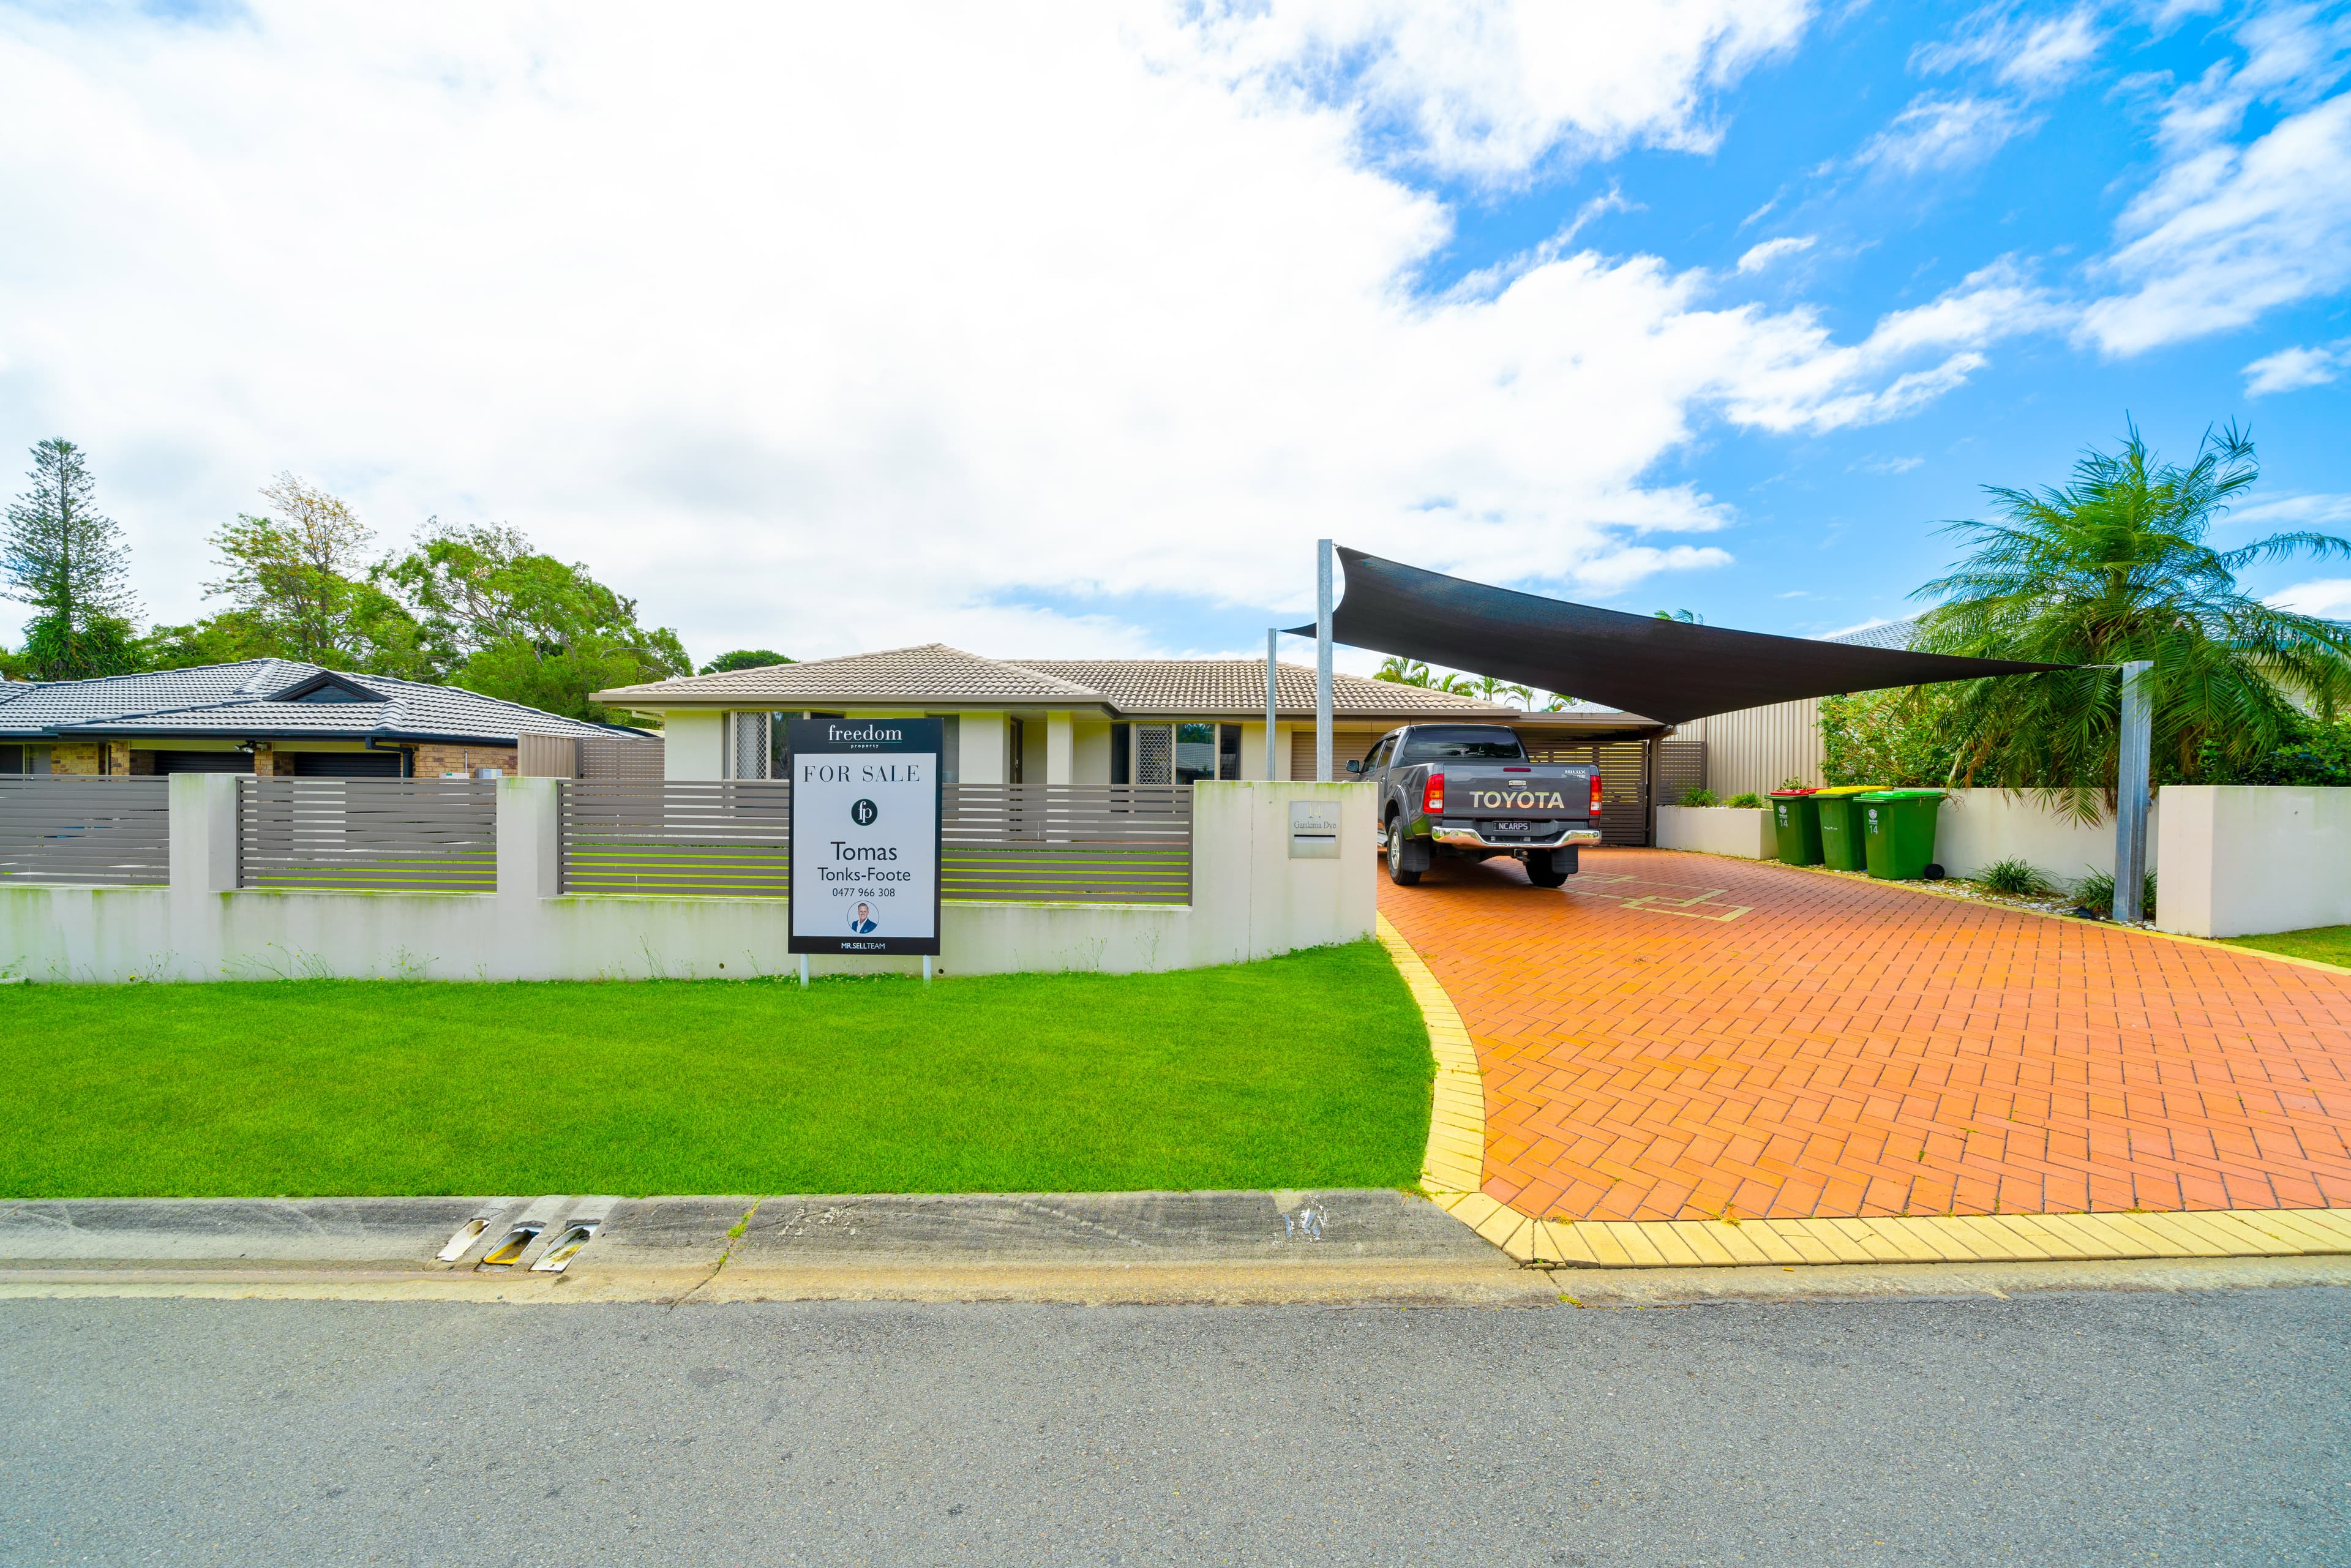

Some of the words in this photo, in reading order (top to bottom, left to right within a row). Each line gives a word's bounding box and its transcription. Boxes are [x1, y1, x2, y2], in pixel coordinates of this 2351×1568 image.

[828, 724, 902, 741] freedom
[803, 765, 851, 782] FOR
[863, 765, 920, 782] SALE
[1469, 791, 1565, 809] TOYOTA
[1869, 825, 1878, 835] 14
[830, 841, 898, 861] Tomas
[817, 867, 911, 882] Tonks-Foote
[833, 888, 855, 897] 0477
[858, 888, 875, 897] 966
[879, 888, 895, 897] 308
